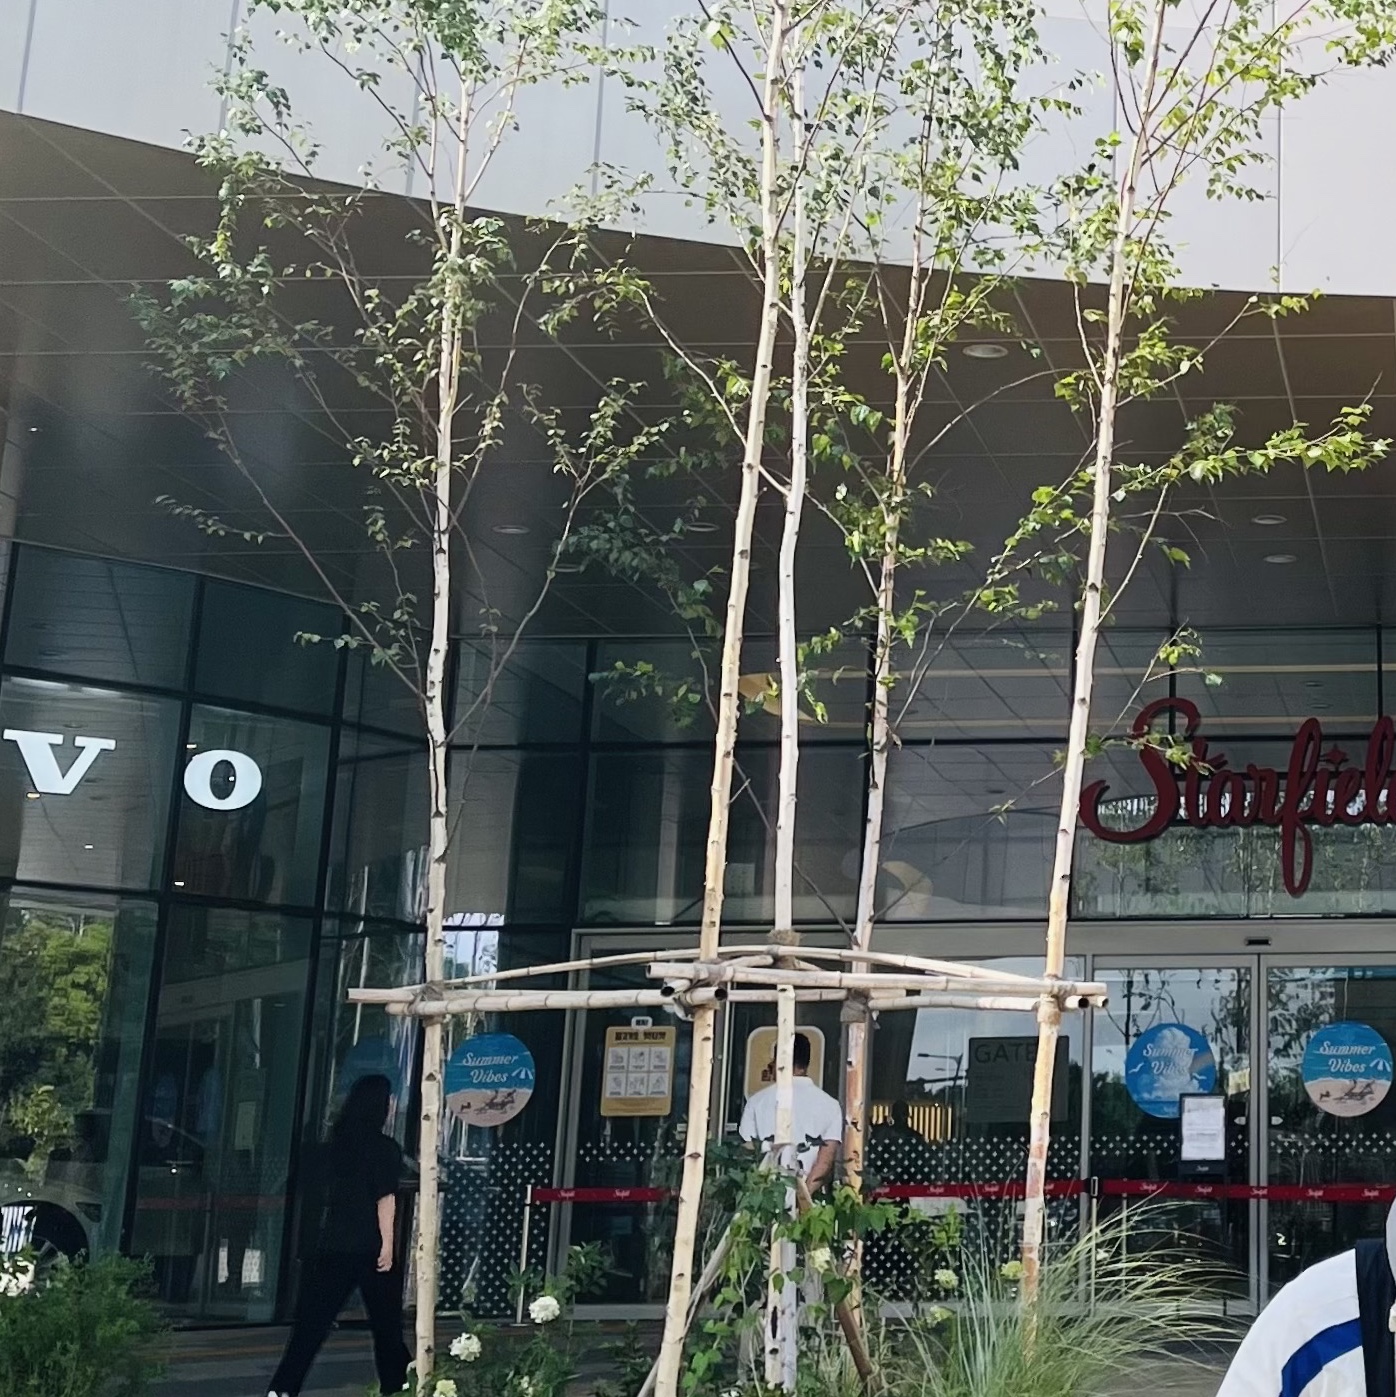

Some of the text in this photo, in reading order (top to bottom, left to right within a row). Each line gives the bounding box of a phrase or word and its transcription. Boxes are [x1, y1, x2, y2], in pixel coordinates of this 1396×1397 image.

[1143, 1043, 1199, 1057] Summer
[1320, 1041, 1376, 1055] Summer
[463, 1052, 519, 1066] Summer
[1328, 1058, 1366, 1072] Vibes
[1151, 1061, 1187, 1075] Vibes
[470, 1069, 508, 1083] Vibes
